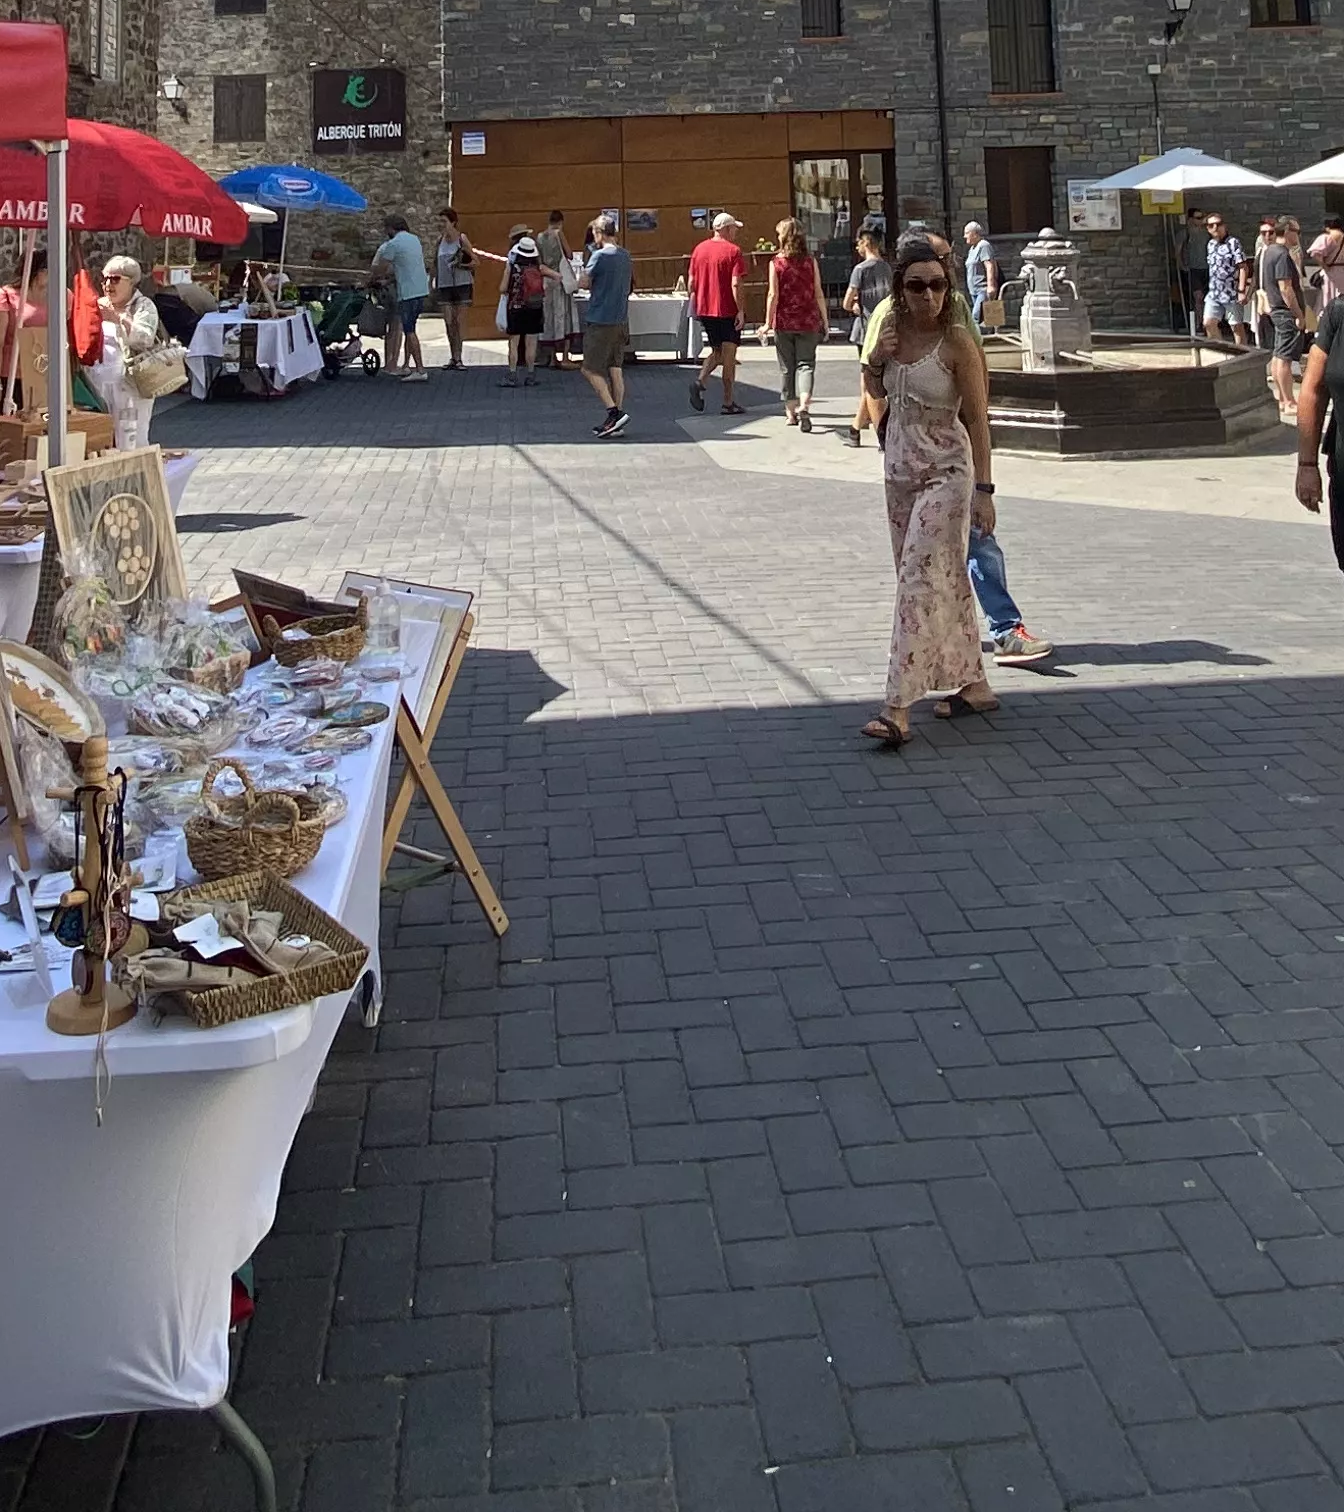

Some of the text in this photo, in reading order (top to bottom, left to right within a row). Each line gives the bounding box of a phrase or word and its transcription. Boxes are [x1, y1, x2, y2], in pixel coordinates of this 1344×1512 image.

[317, 120, 402, 141] ALBERGUE TRITÓN
[161, 213, 213, 237] AMBAR
